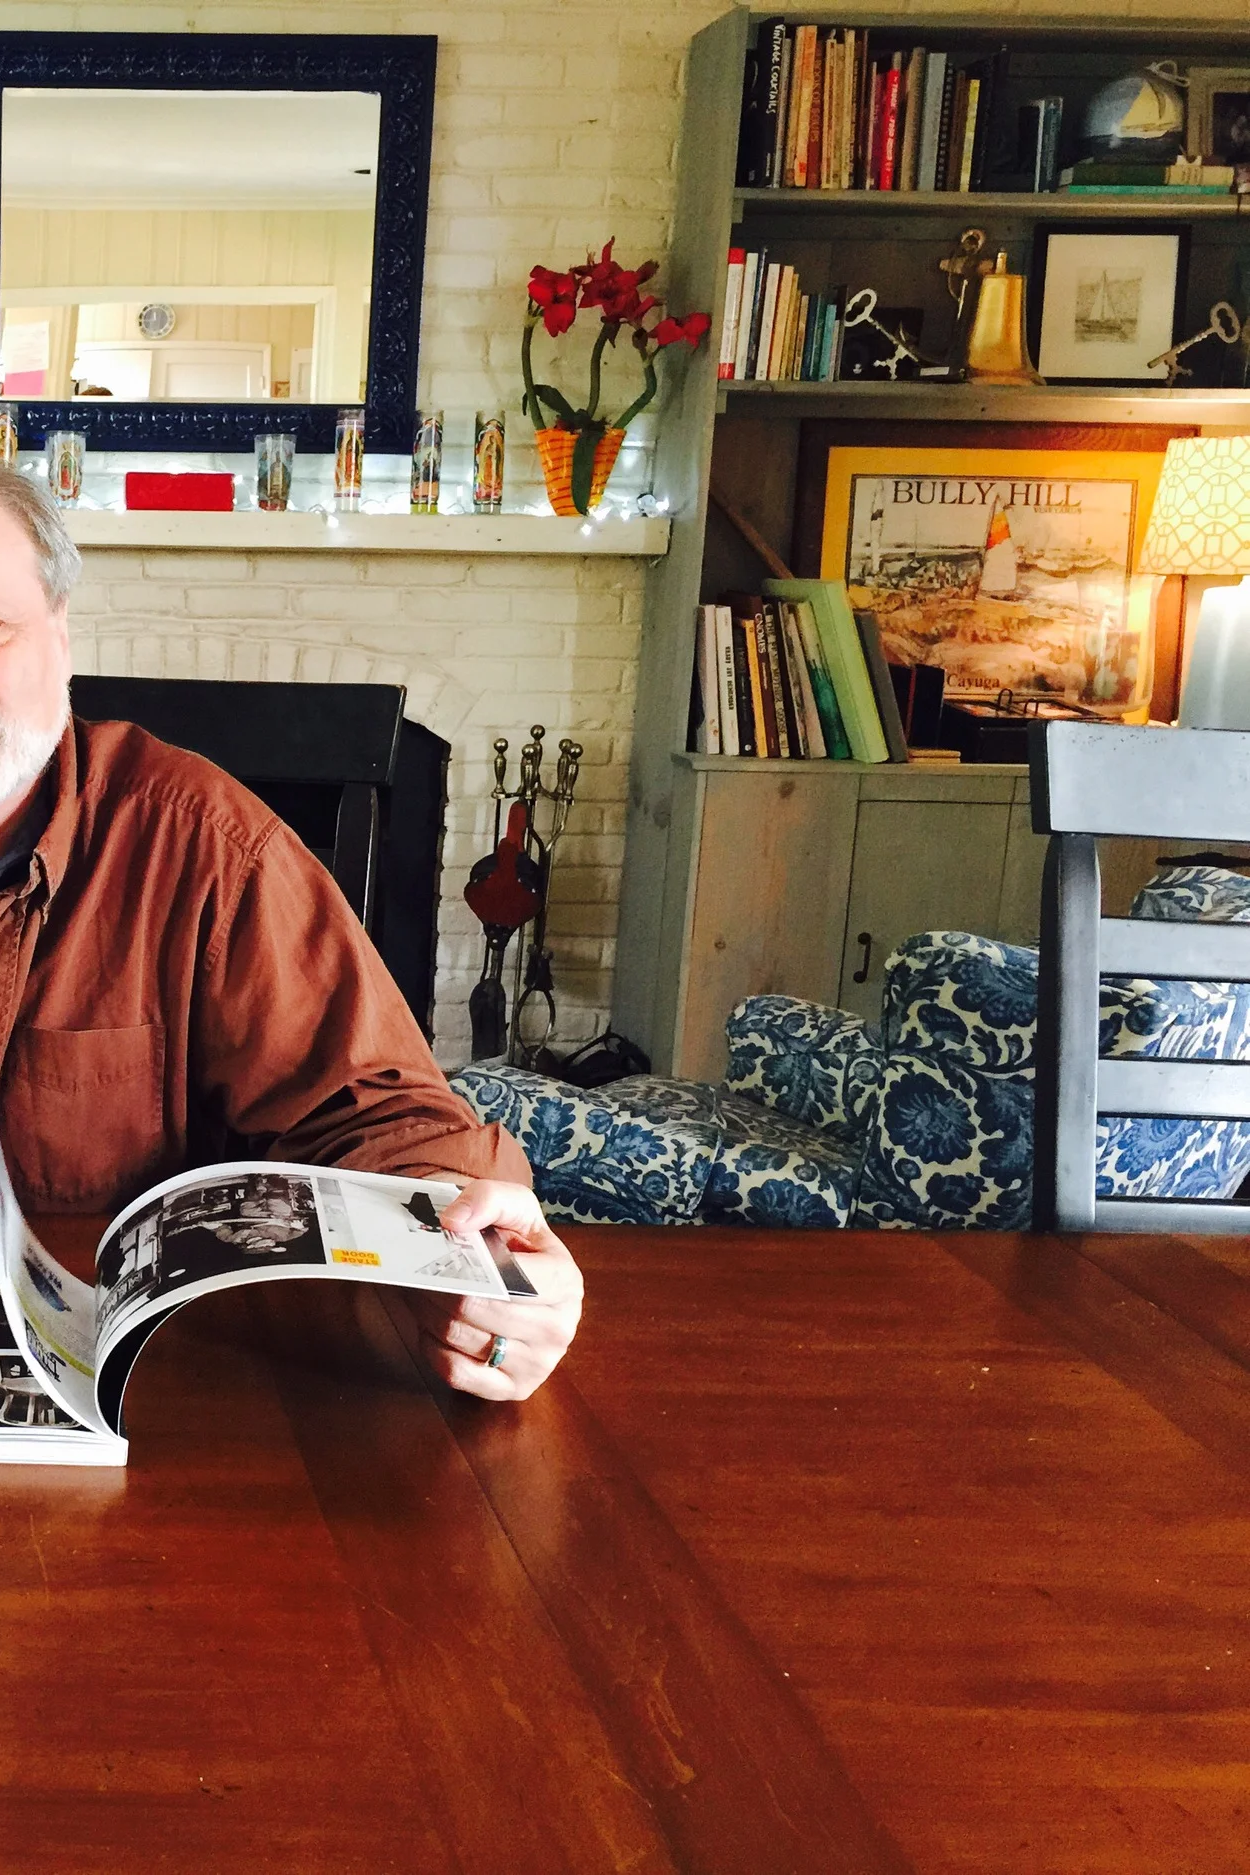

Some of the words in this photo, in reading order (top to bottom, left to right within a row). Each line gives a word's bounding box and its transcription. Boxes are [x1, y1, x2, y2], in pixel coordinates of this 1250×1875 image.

[893, 480, 996, 505] BULLY
[1009, 482, 1082, 507] HILL
[754, 612, 766, 654] GNOMES
[946, 673, 1000, 690] Cayuga
[342, 1250, 375, 1259] DOOR
